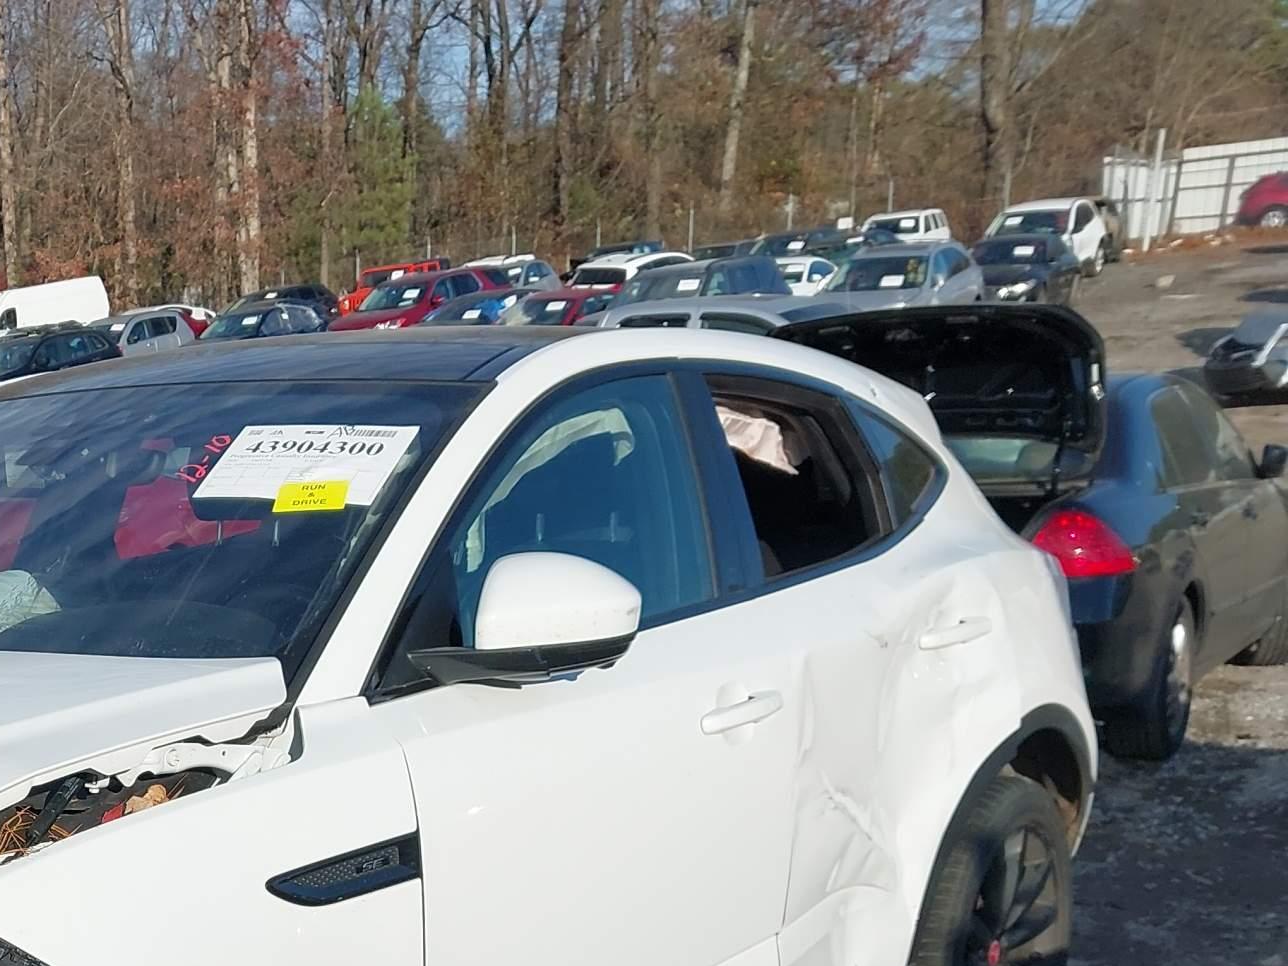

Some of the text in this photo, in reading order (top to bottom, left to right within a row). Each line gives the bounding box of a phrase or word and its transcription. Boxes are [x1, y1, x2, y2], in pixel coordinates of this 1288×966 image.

[245, 440, 384, 456] 43904300
[176, 434, 232, 483] 12-10
[292, 498, 327, 506] DRIVE
